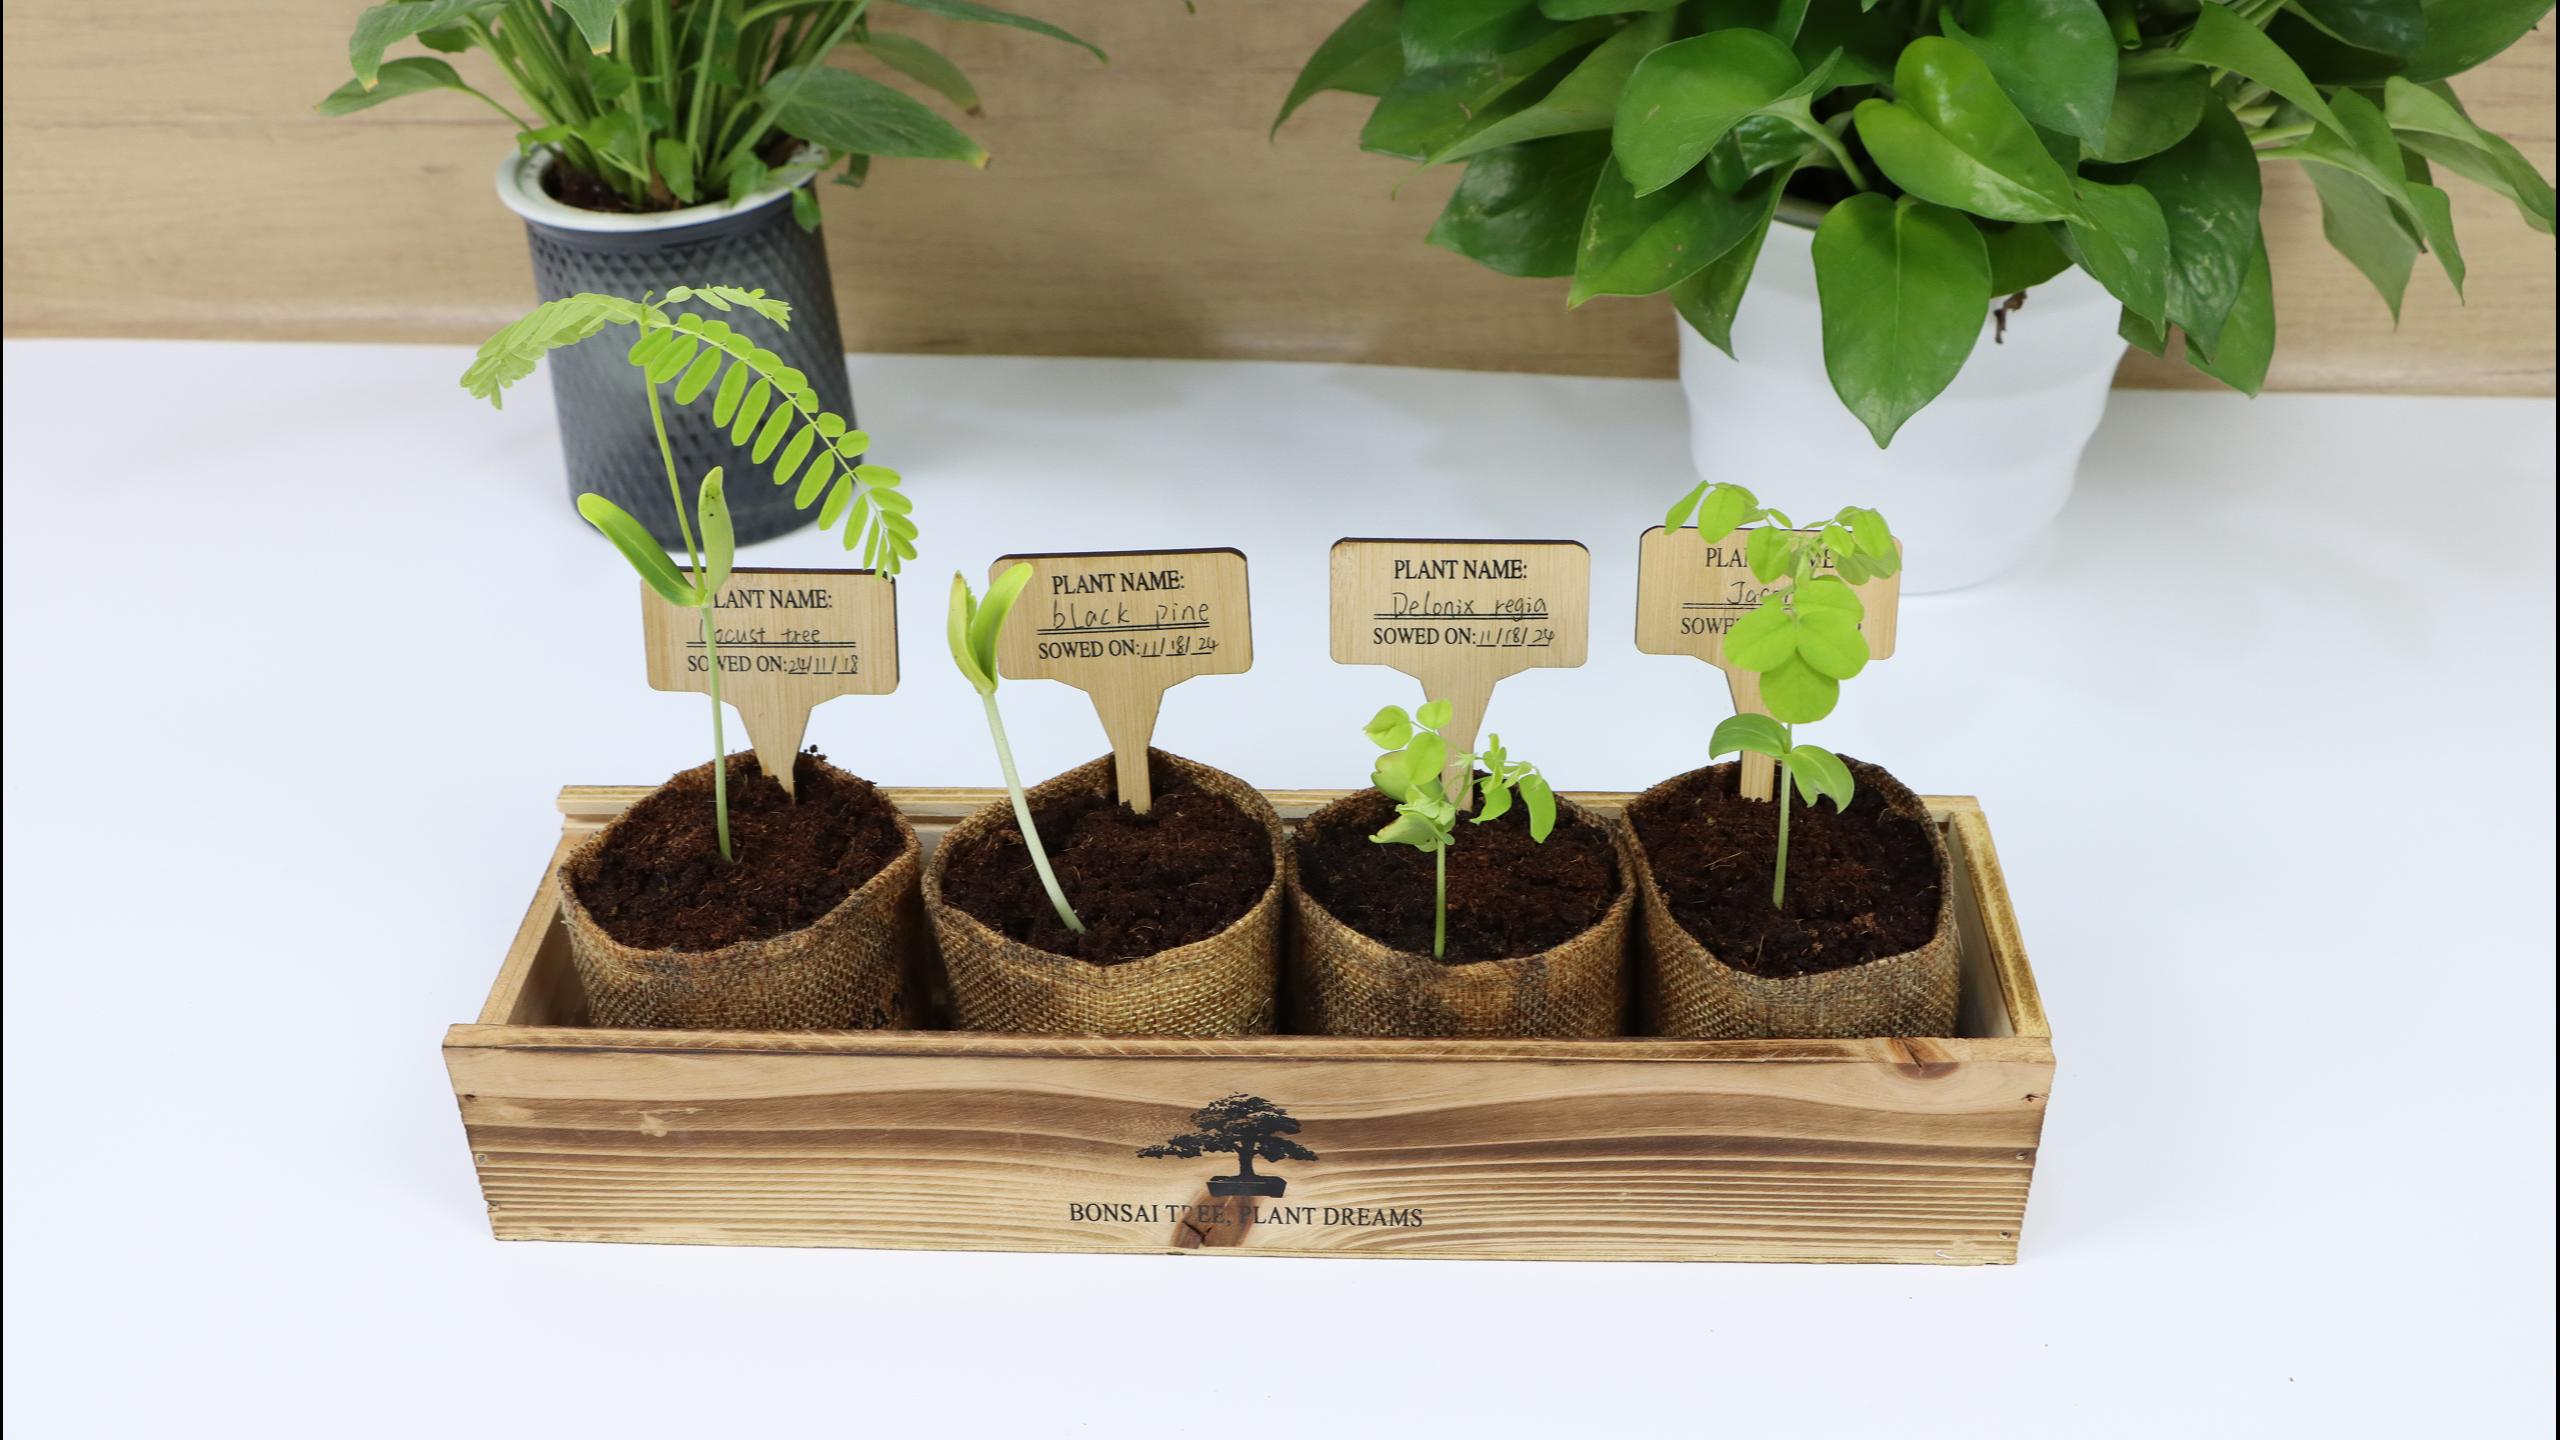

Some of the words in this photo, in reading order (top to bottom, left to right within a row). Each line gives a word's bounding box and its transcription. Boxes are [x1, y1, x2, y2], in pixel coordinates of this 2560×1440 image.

[1705, 547, 1748, 568] PLA
[1394, 560, 1458, 579] PLANT
[1463, 560, 1527, 579] NAME:
[1052, 574, 1115, 594] PLANT
[1121, 570, 1184, 592] NAME:
[714, 589, 764, 609] LANT
[769, 590, 832, 609] NAME:
[1392, 591, 1474, 618] Delonix
[1495, 599, 1547, 622] regia
[1155, 602, 1209, 630] pine
[1680, 617, 1740, 635] SOWE
[781, 627, 820, 643] tree
[1373, 628, 1439, 645] SOWED
[1444, 628, 1476, 645] ON:
[1038, 641, 1102, 660] SOWED
[1108, 639, 1140, 657] ON:
[756, 655, 788, 672] ON:
[1069, 1203, 1158, 1223] BONSAI
[1238, 1205, 1316, 1225] PLANT
[1323, 1208, 1424, 1228] DREAMS
